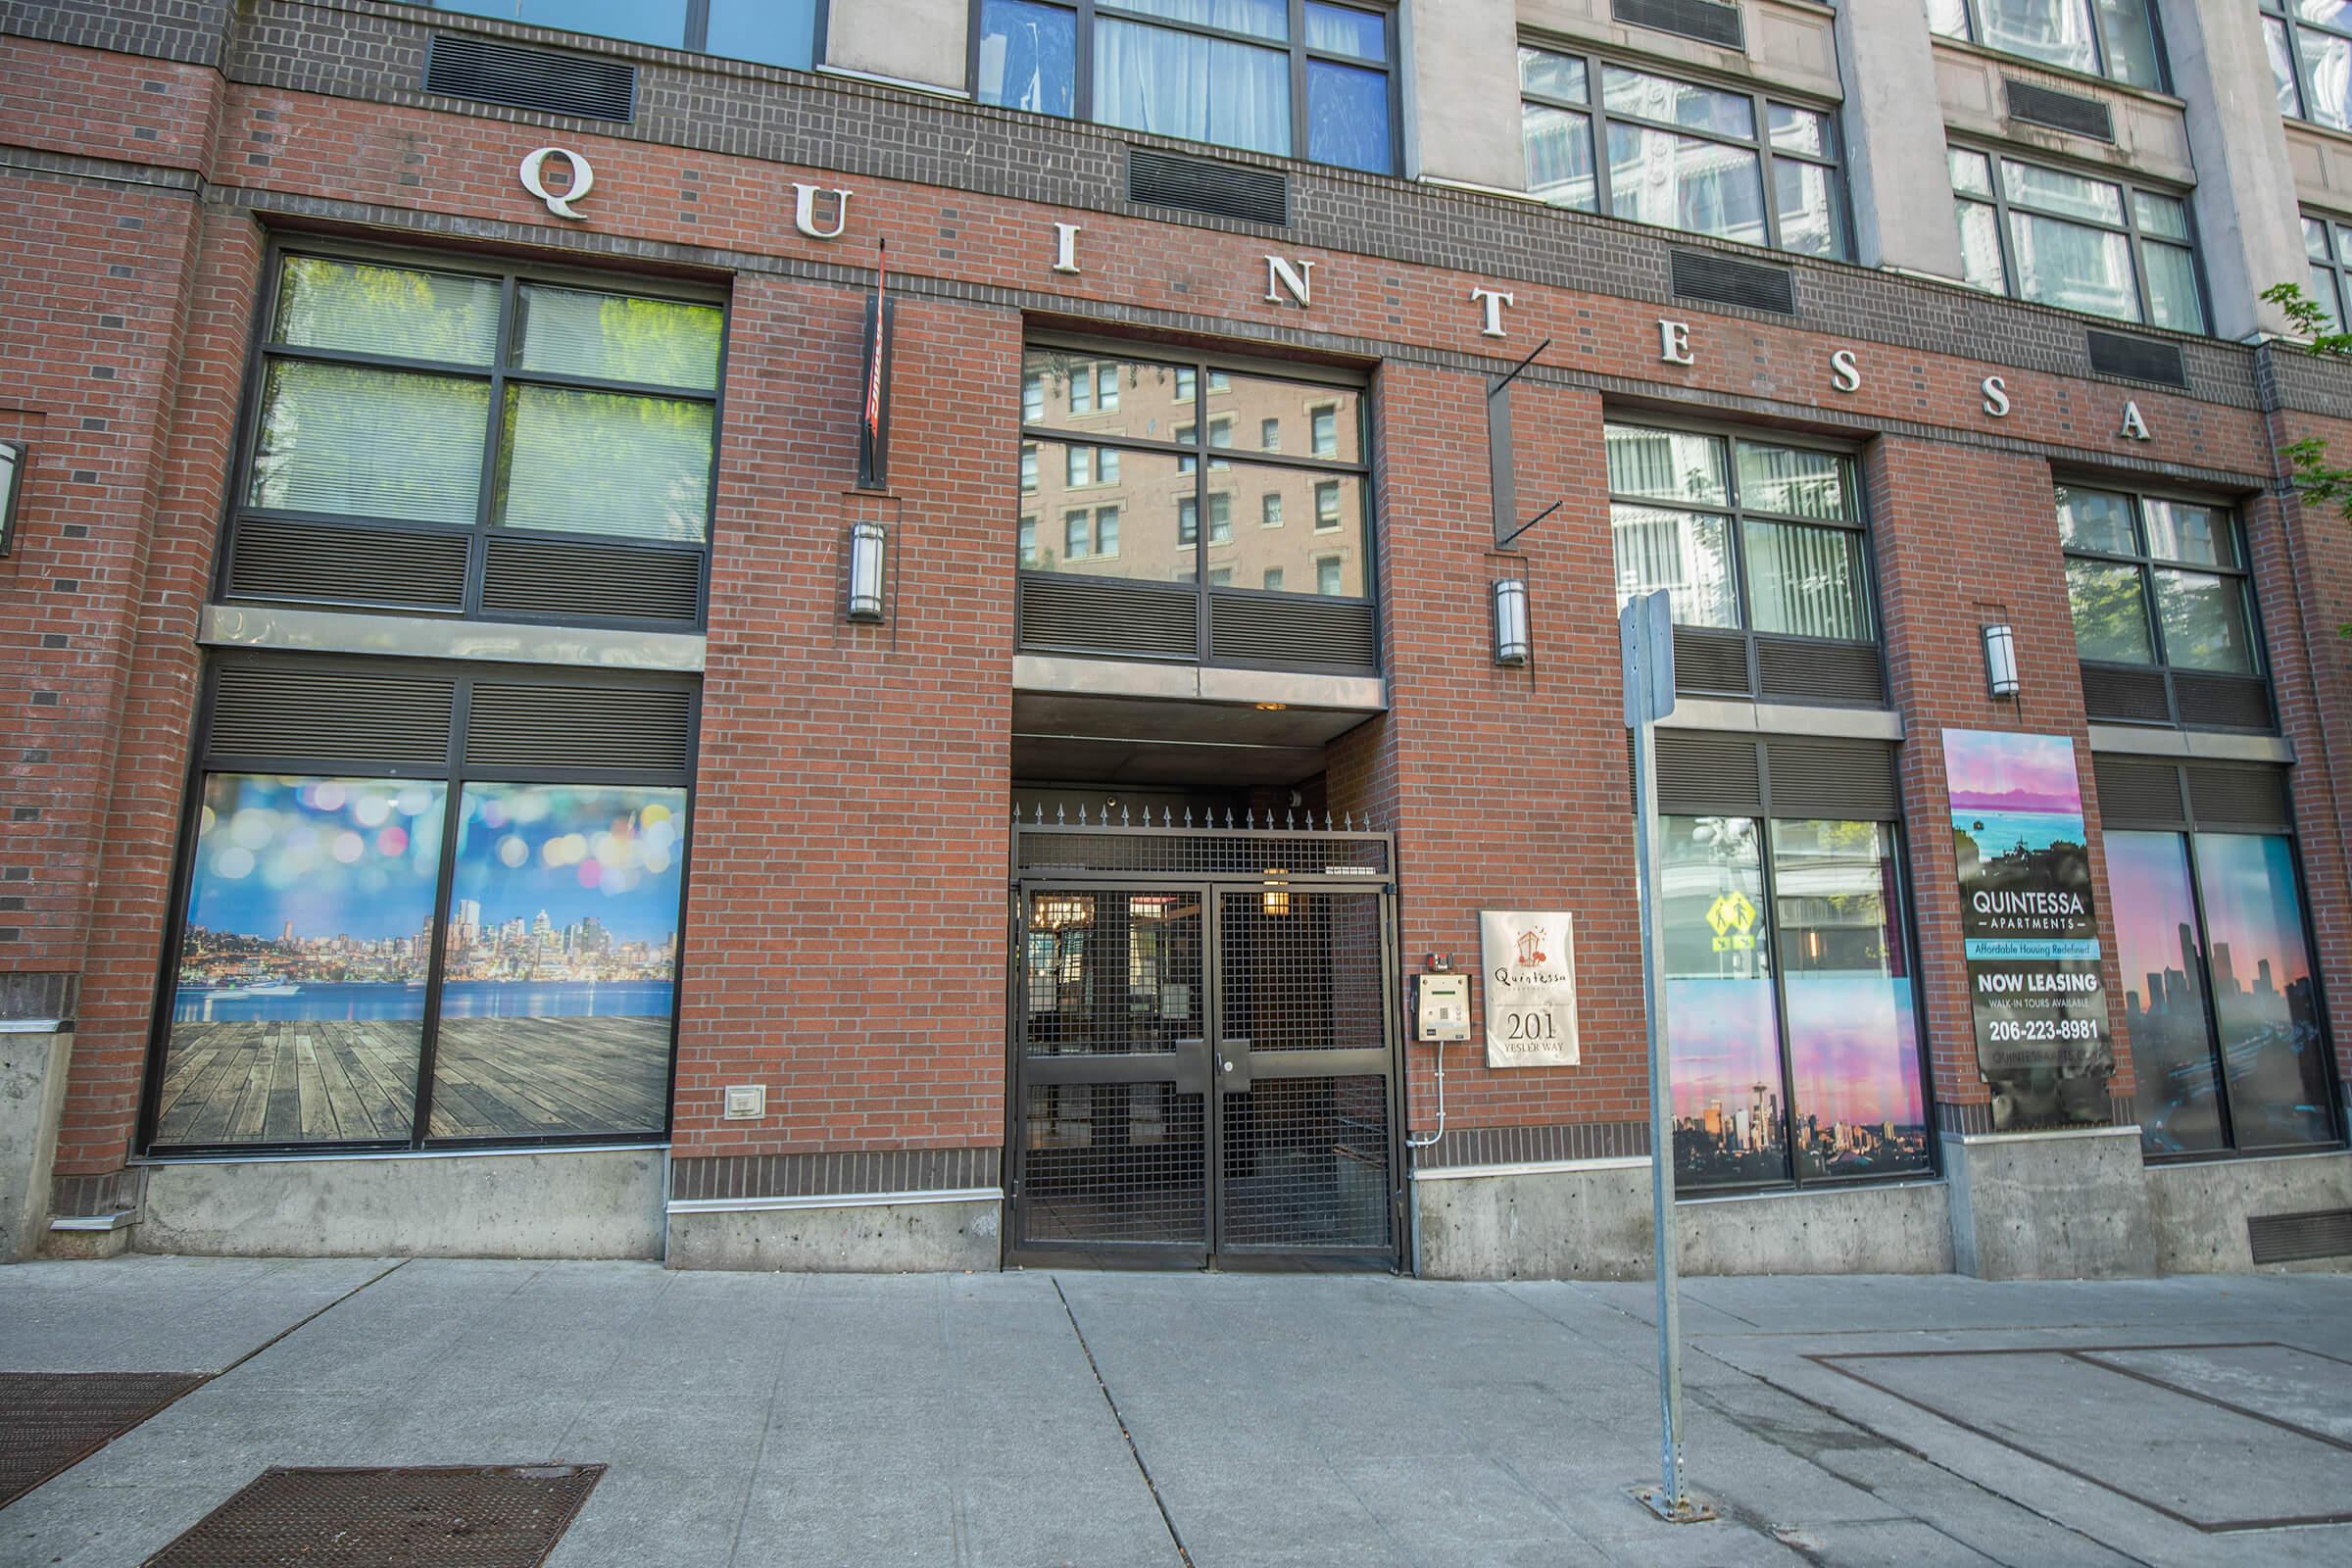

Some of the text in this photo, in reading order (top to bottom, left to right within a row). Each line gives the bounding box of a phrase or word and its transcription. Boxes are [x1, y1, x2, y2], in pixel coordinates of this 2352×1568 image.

[519, 146, 2152, 441] QUINTESSA
[1973, 890, 2084, 914] QUINTESSA
[1990, 917, 2075, 930] APARTMENTS
[1975, 944, 2090, 956] Affordable Housing Redefined
[1494, 967, 1566, 986] Quintessa
[1978, 973, 2098, 993] NOW LEASING
[1988, 998, 2089, 1008] WALK-IN TOURS AVAILABLE
[1507, 1012, 1556, 1040] 201
[1989, 1019, 2098, 1041] 206-223-8981
[1504, 1042, 1564, 1053] YESLER WAY
